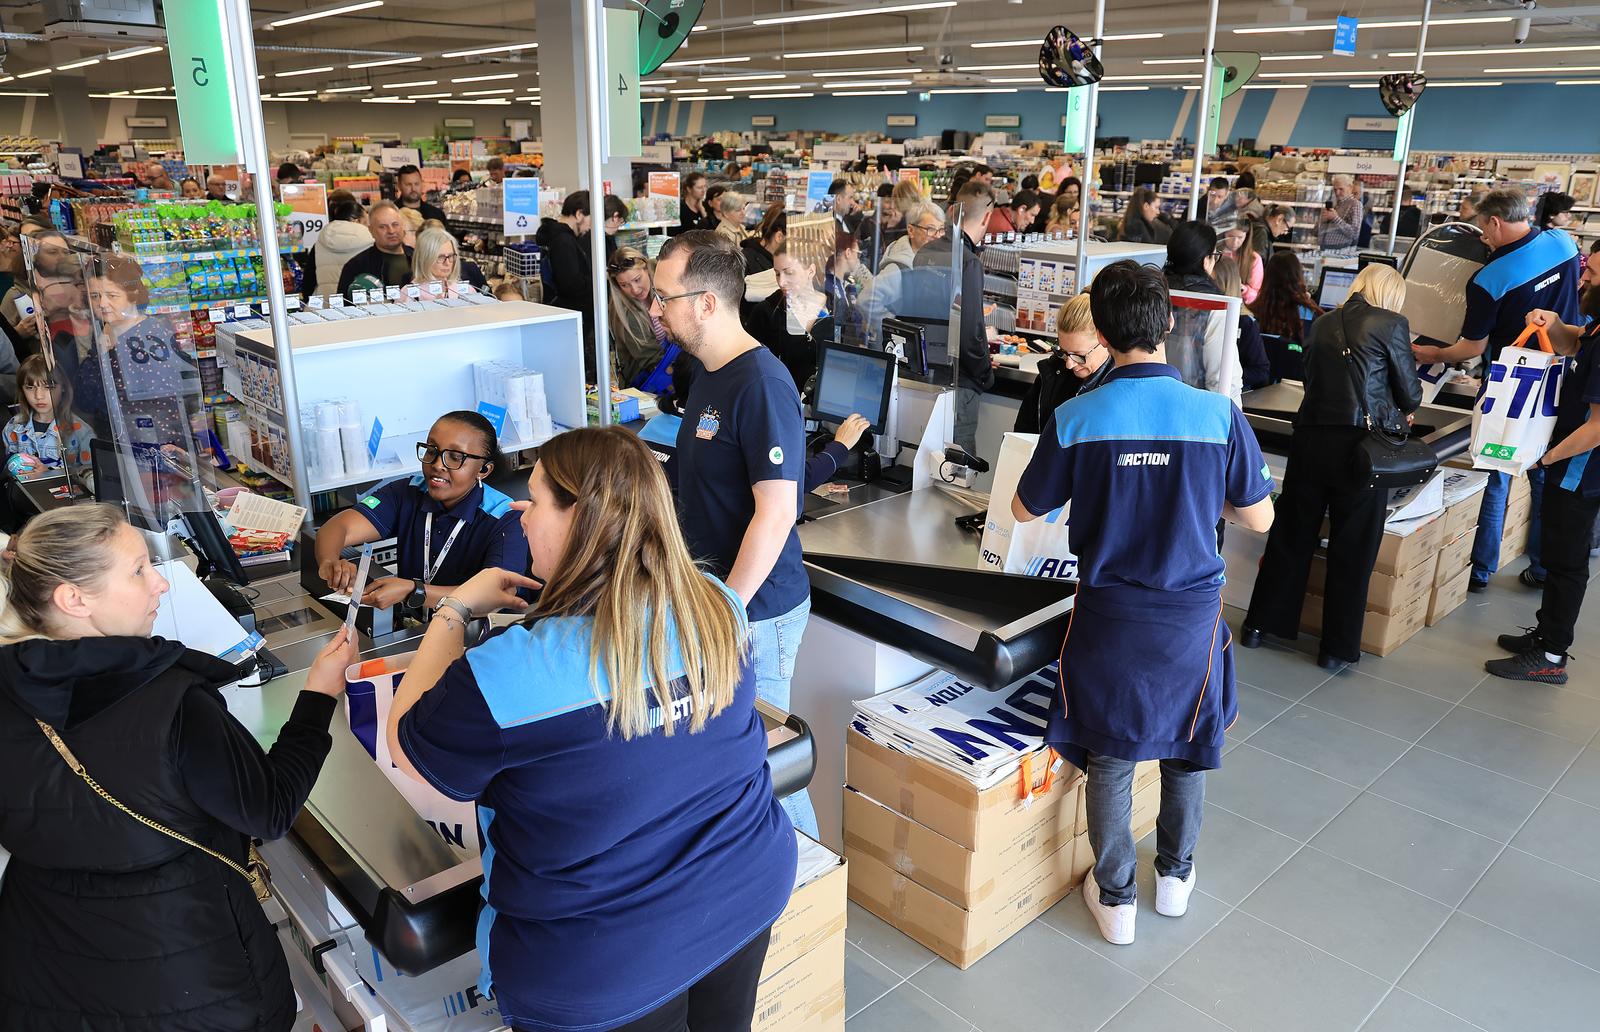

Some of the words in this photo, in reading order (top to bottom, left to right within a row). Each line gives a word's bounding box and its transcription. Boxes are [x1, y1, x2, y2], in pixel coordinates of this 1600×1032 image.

[1356, 162, 1373, 171] boja
[305, 219, 323, 233] 99
[1537, 272, 1561, 292] ACTION
[1124, 452, 1171, 467] ACTION
[1037, 557, 1079, 578] AC
[924, 681, 975, 707] TION
